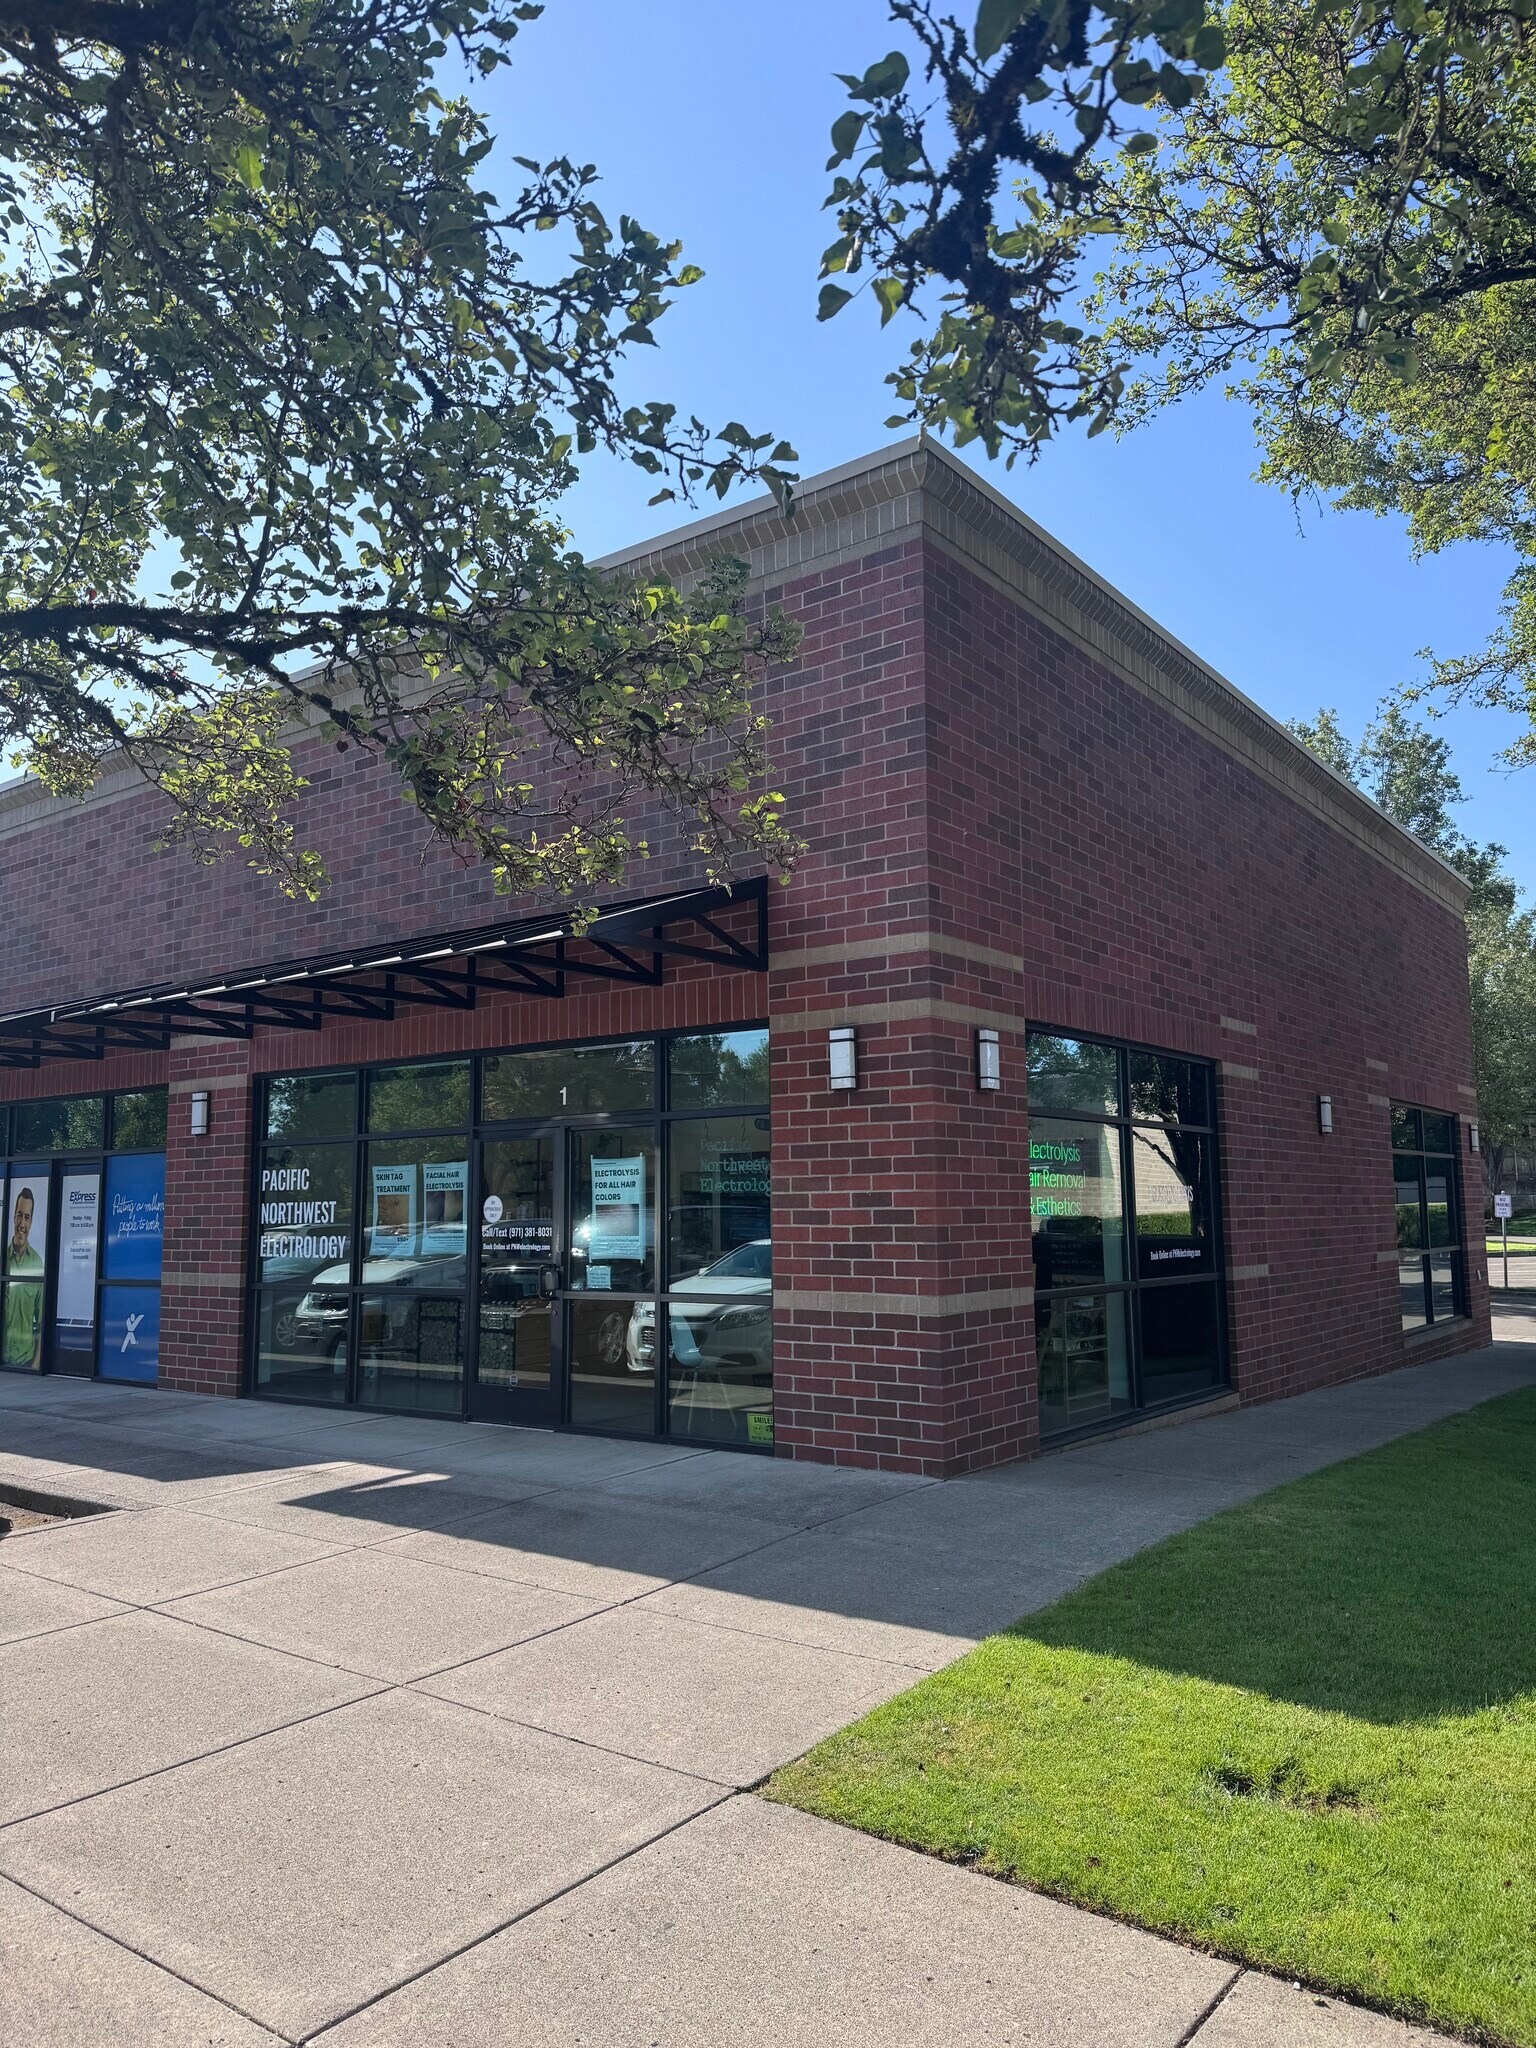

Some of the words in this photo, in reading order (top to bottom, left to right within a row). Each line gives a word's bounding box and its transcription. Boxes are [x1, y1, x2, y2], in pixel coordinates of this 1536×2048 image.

[559, 1086, 567, 1105] 1
[1028, 1139, 1080, 1166] lectrolysis
[594, 1168, 640, 1177] ELECTROLYSIS
[700, 1157, 769, 1173] Northwest
[262, 1168, 310, 1191] PACIFIC
[426, 1171, 446, 1179] FACIAL
[1029, 1168, 1041, 1187] air
[1043, 1168, 1086, 1189] Removal
[376, 1185, 410, 1193] TREATMENT
[426, 1182, 464, 1190] ELECTROLYSIS
[595, 1181, 608, 1189] FOR
[608, 1181, 620, 1189] ALL
[620, 1180, 636, 1188] HAIR
[700, 1178, 771, 1197] Electrolog
[69, 1190, 97, 1203] Express
[595, 1193, 621, 1201] COLORS
[113, 1194, 135, 1219] Putting
[136, 1202, 144, 1212] a
[261, 1201, 336, 1224] NORTHWEST
[1036, 1196, 1081, 1216] Esthetics
[118, 1214, 138, 1239] people
[138, 1217, 146, 1230] to
[146, 1213, 161, 1233] work
[482, 1227, 508, 1237] Call/Text
[509, 1227, 524, 1239] (971)
[524, 1227, 552, 1237] 381-8031
[260, 1235, 346, 1259] ELECTROLOGY
[1150, 1251, 1159, 1261] Book
[1159, 1249, 1169, 1260] Online
